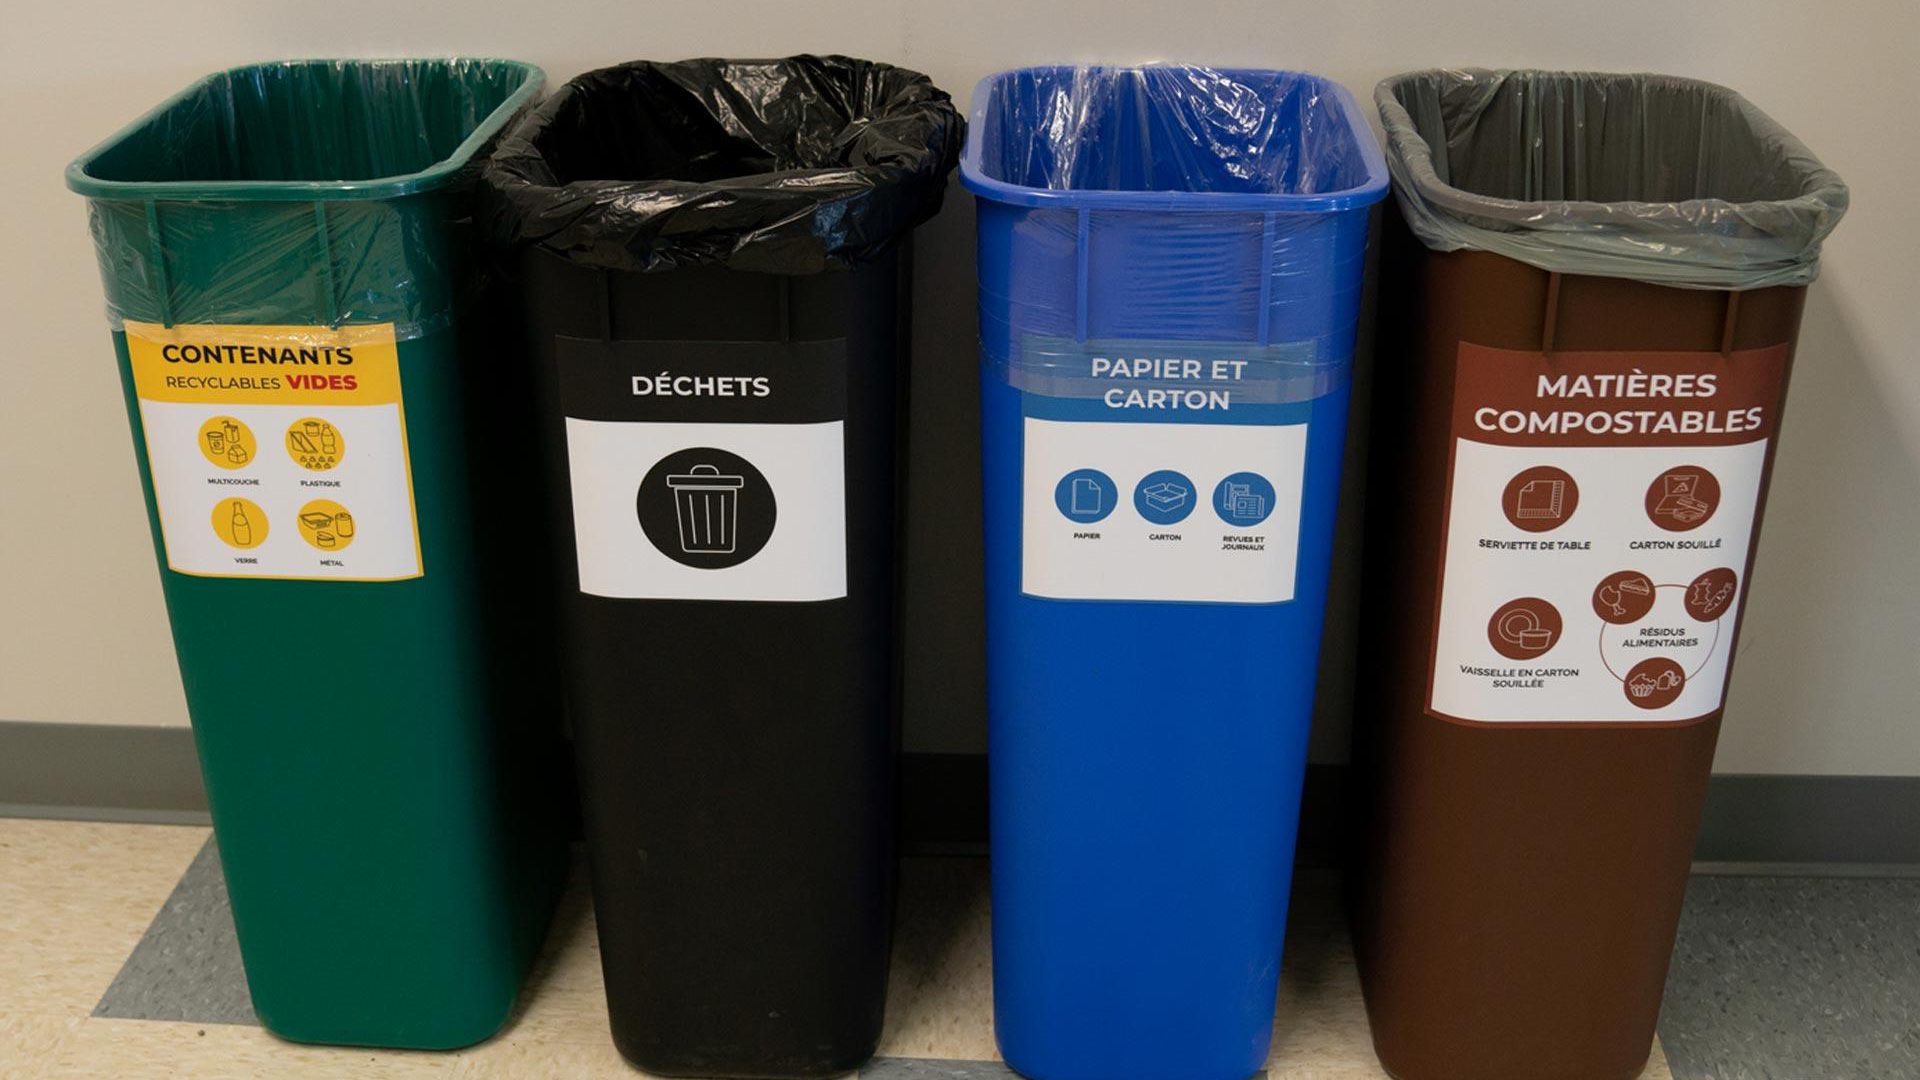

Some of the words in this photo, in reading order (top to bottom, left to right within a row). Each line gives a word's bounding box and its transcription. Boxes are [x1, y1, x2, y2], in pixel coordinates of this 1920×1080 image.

[162, 344, 353, 365] CONTENANTS
[1091, 358, 1201, 379] PAPIER
[1211, 360, 1248, 380] ET
[166, 376, 280, 390] RECYCLABLES
[285, 374, 358, 391] VIDES
[631, 371, 770, 397] DÉCHETS
[1537, 368, 1717, 398] MATIÈRES
[1104, 388, 1230, 410] CARTON
[1474, 407, 1763, 435] COMPOSTABLES
[208, 478, 260, 486] MULTICOUCHE
[301, 480, 341, 488] PLASTIQUE
[1073, 532, 1101, 540] PAPIER
[1478, 538, 1537, 550] SERVIETTE
[1540, 541, 1555, 550] DE
[1557, 541, 1591, 550] TABLE
[1629, 541, 1675, 550] CARTON
[1677, 538, 1722, 550] SOUILLÉ
[234, 557, 258, 565] VERRE
[1640, 627, 1685, 637] RÉSIDUS
[1622, 638, 1699, 648] ALIMENTAIRES
[1460, 665, 1516, 678] VAISSELLE
[1518, 669, 1533, 677] EN
[1535, 668, 1579, 677] CARTON
[1492, 678, 1544, 688] SOUILLÉE
